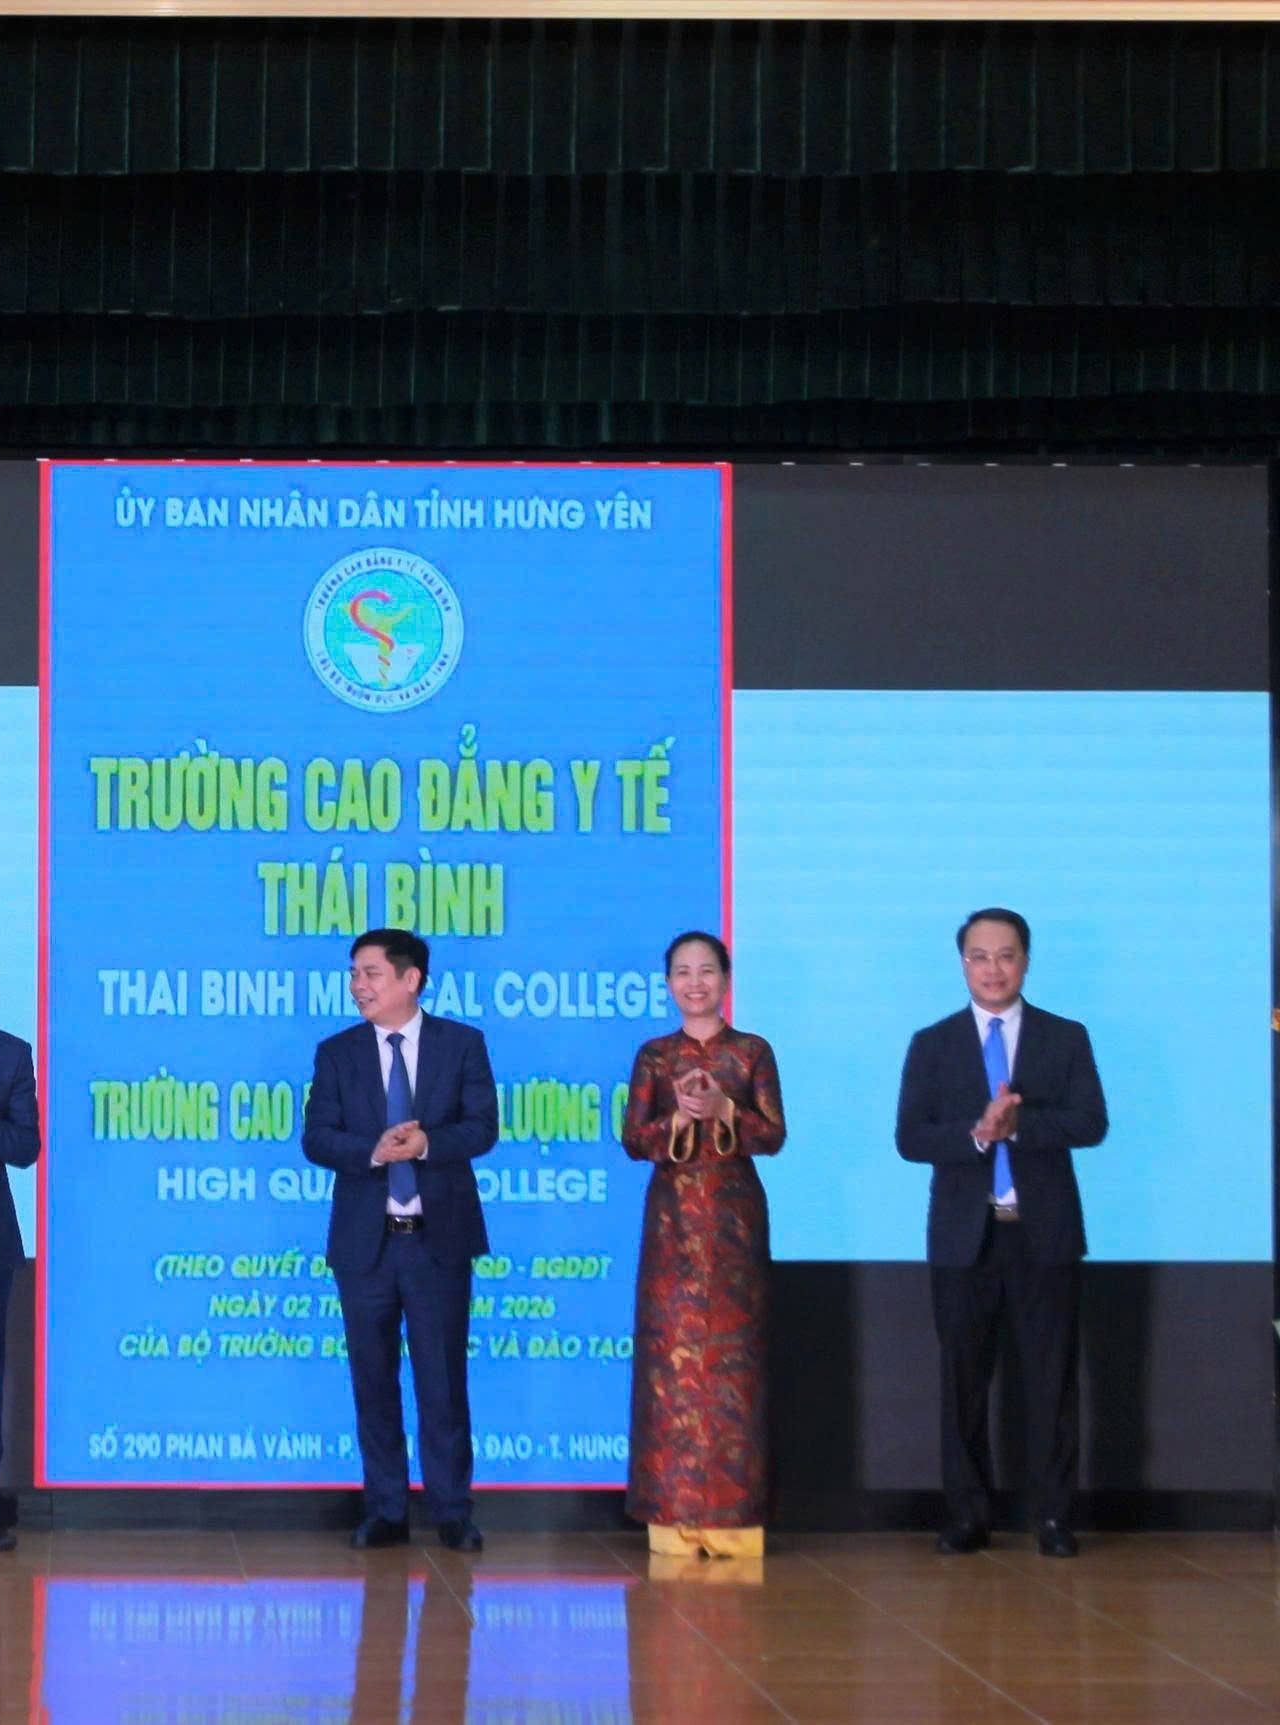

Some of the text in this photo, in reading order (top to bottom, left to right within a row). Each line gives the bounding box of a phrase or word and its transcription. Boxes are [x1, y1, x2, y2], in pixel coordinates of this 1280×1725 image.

[116, 486, 652, 530] ỦY BAN NHÂN DÂN TỈNH HƯNG YÊN
[89, 723, 676, 833] TRƯỜNG CAO ĐẲNG Y TẾ
[257, 846, 504, 937] THÁI BÌNH
[98, 970, 188, 1016] THAI
[201, 970, 295, 1016] BINH
[493, 970, 668, 1018] COLLEGE
[89, 1067, 219, 1141] TRƯỜNG
[229, 1080, 294, 1141] CAO
[496, 1077, 602, 1156] LƯỢNG
[157, 1167, 256, 1201] HIGH
[475, 1168, 607, 1203] OLLEGE
[231, 1247, 305, 1279] QUYẾT
[208, 1288, 279, 1318] NGÀY
[283, 1295, 312, 1319] 02
[499, 1295, 557, 1319] 2026
[119, 1325, 170, 1357] CỦA
[176, 1327, 212, 1365] BỘ
[488, 1329, 520, 1358] VÀ
[587, 1336, 634, 1366] TẠO
[89, 1423, 119, 1459] SỐ
[123, 1433, 161, 1459] 290
[166, 1433, 223, 1459] PHAN
[229, 1425, 257, 1459] BÁ
[262, 1427, 321, 1459] VÀNH
